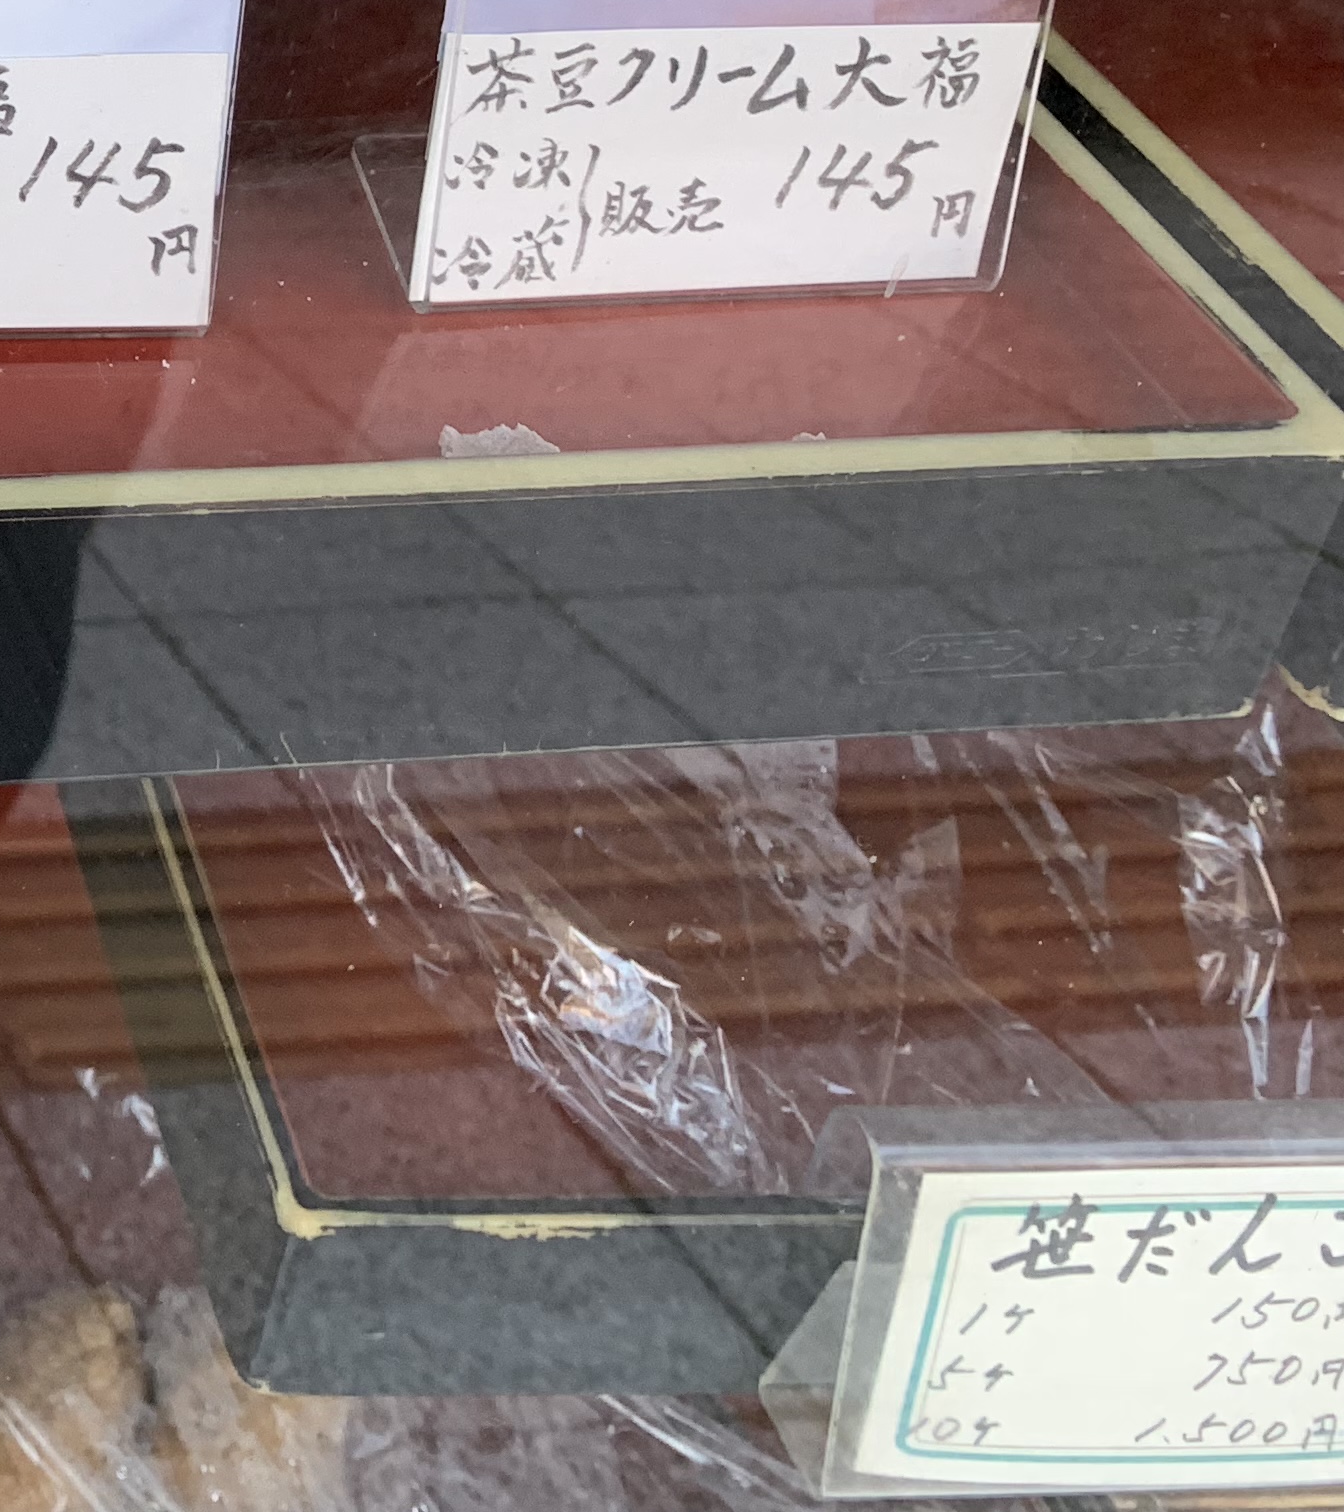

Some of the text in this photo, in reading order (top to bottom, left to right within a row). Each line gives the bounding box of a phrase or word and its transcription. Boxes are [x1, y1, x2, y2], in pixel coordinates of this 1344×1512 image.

[464, 35, 981, 115] 茶豆クリーム大福
[444, 137, 572, 191] 冷凍
[598, 176, 725, 237] 販売
[431, 214, 571, 291] 冷蔵
